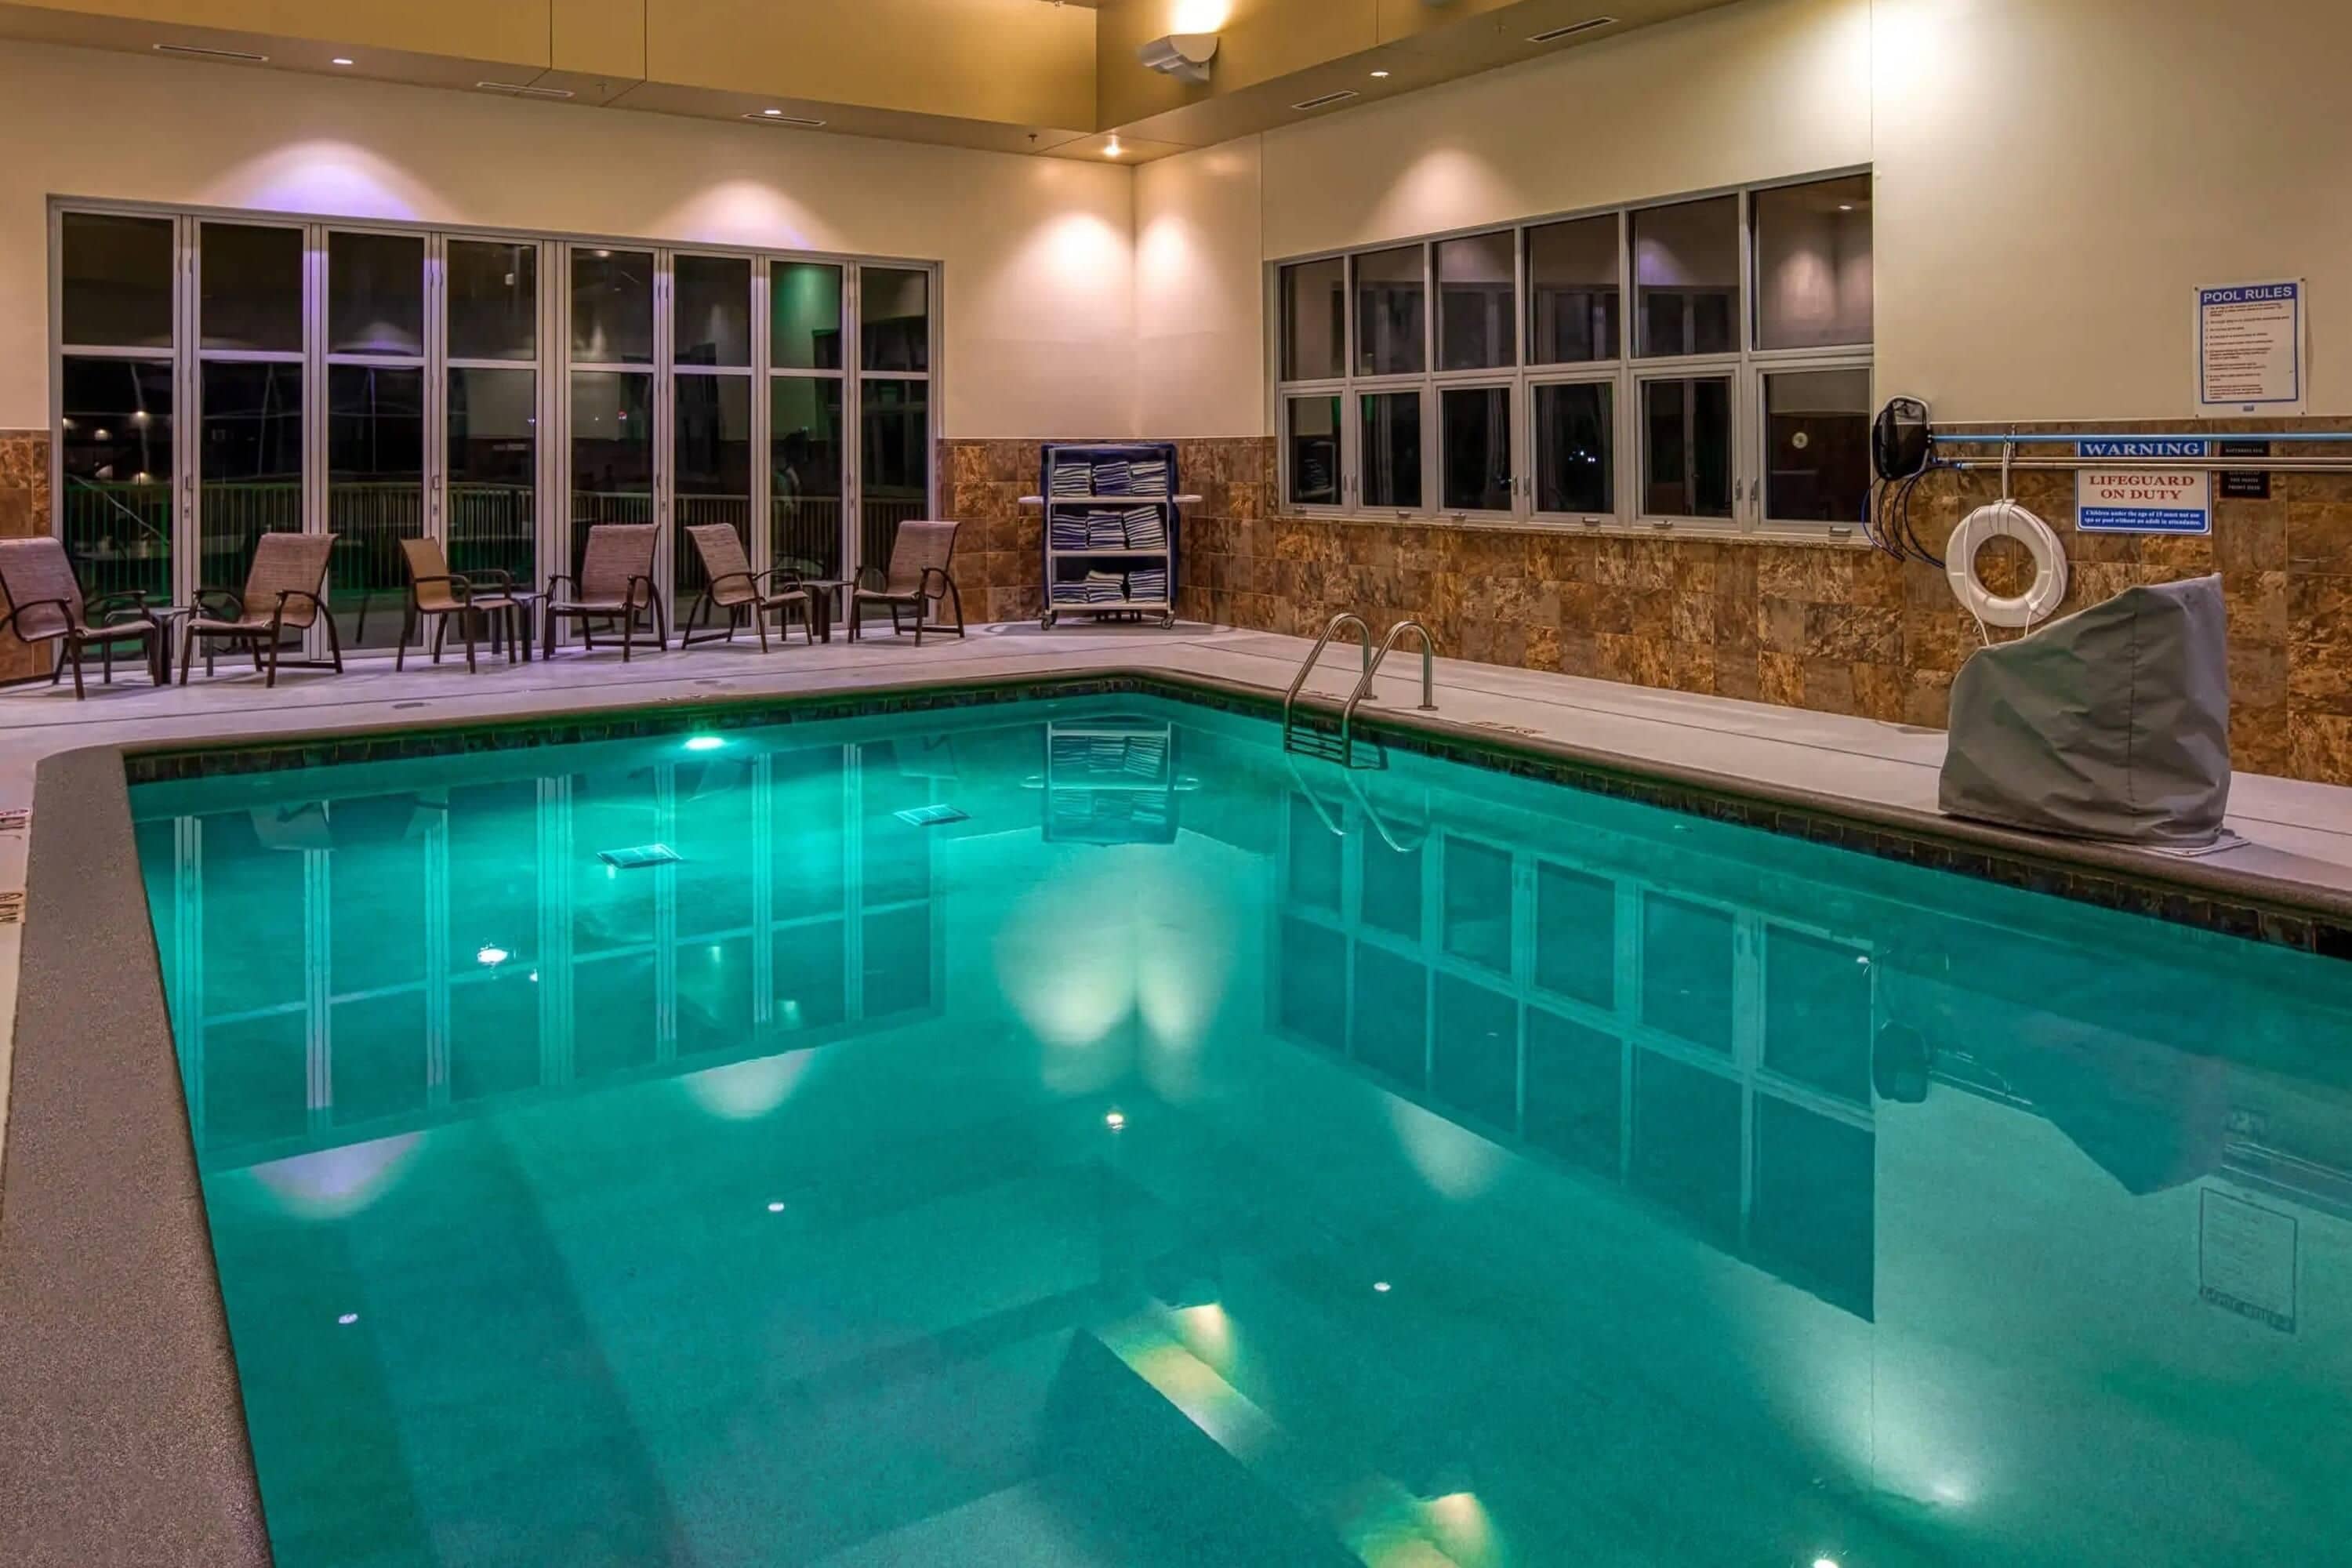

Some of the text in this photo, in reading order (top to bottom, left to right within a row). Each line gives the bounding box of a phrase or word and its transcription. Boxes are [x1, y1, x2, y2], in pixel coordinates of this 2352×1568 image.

[2203, 286, 2292, 303] POOL RULES
[2085, 443, 2200, 456] WARNING
[2089, 476, 2194, 486] LIFEGUARD
[2100, 489, 2183, 500] ON DUTY
